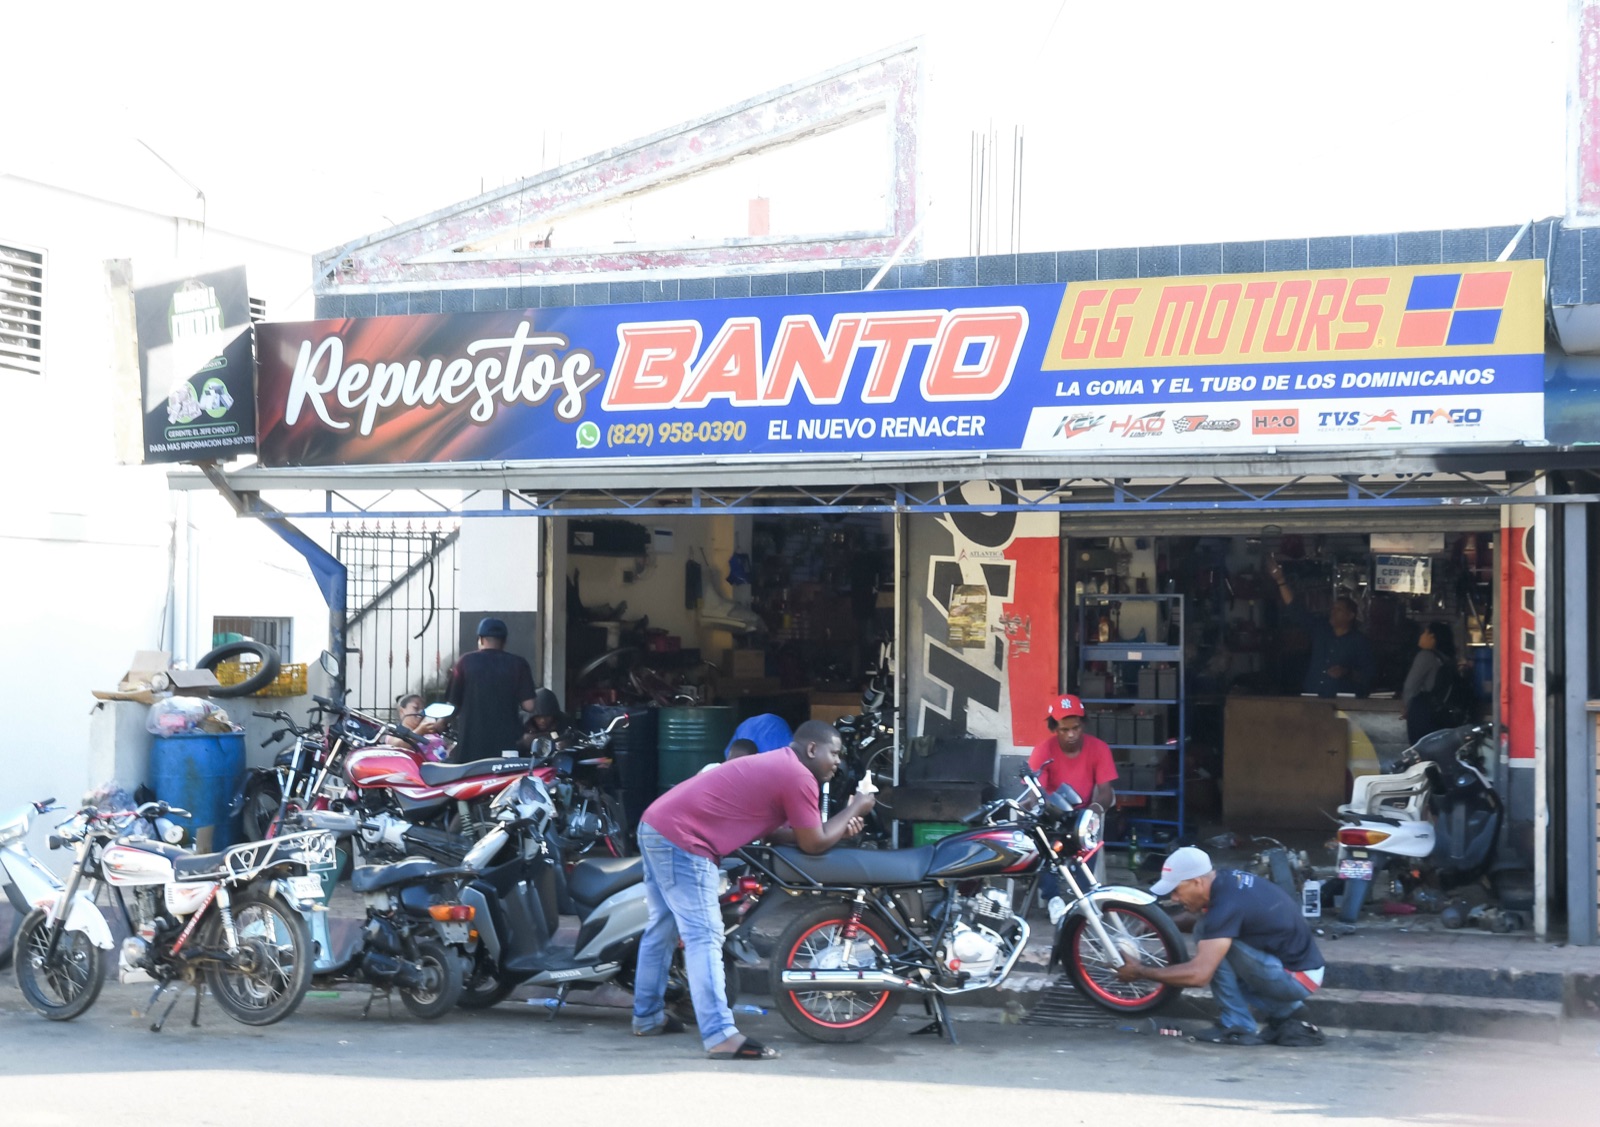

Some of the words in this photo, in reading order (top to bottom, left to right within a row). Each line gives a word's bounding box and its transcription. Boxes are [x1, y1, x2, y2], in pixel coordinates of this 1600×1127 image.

[1061, 287, 1142, 360] GG
[1144, 276, 1391, 358] MOTORS
[601, 306, 1029, 412] BANTO
[285, 320, 601, 436] Repuestos
[1055, 382, 1080, 396] LA
[1086, 380, 1144, 396] GOMA
[1151, 379, 1165, 394] Y
[1169, 378, 1194, 393] EL
[1201, 376, 1256, 392] TUBO
[1261, 375, 1290, 391] DE
[1295, 373, 1336, 390] LOS
[1341, 368, 1495, 389] DOMINICANOS
[768, 420, 792, 440] EL
[797, 417, 876, 439] NUEVO
[880, 415, 986, 438] RENACER
[1109, 414, 1165, 438] HAO
[1255, 414, 1296, 428] HAO
[1317, 411, 1360, 426] TVS
[1411, 408, 1482, 425] MAGO
[193, 427, 200, 436] EL
[607, 423, 654, 448] (829)
[658, 420, 747, 443] 958-0390
[149, 444, 166, 453] PARA
[167, 443, 180, 451] MAS
[181, 439, 221, 450] INFORMACION
